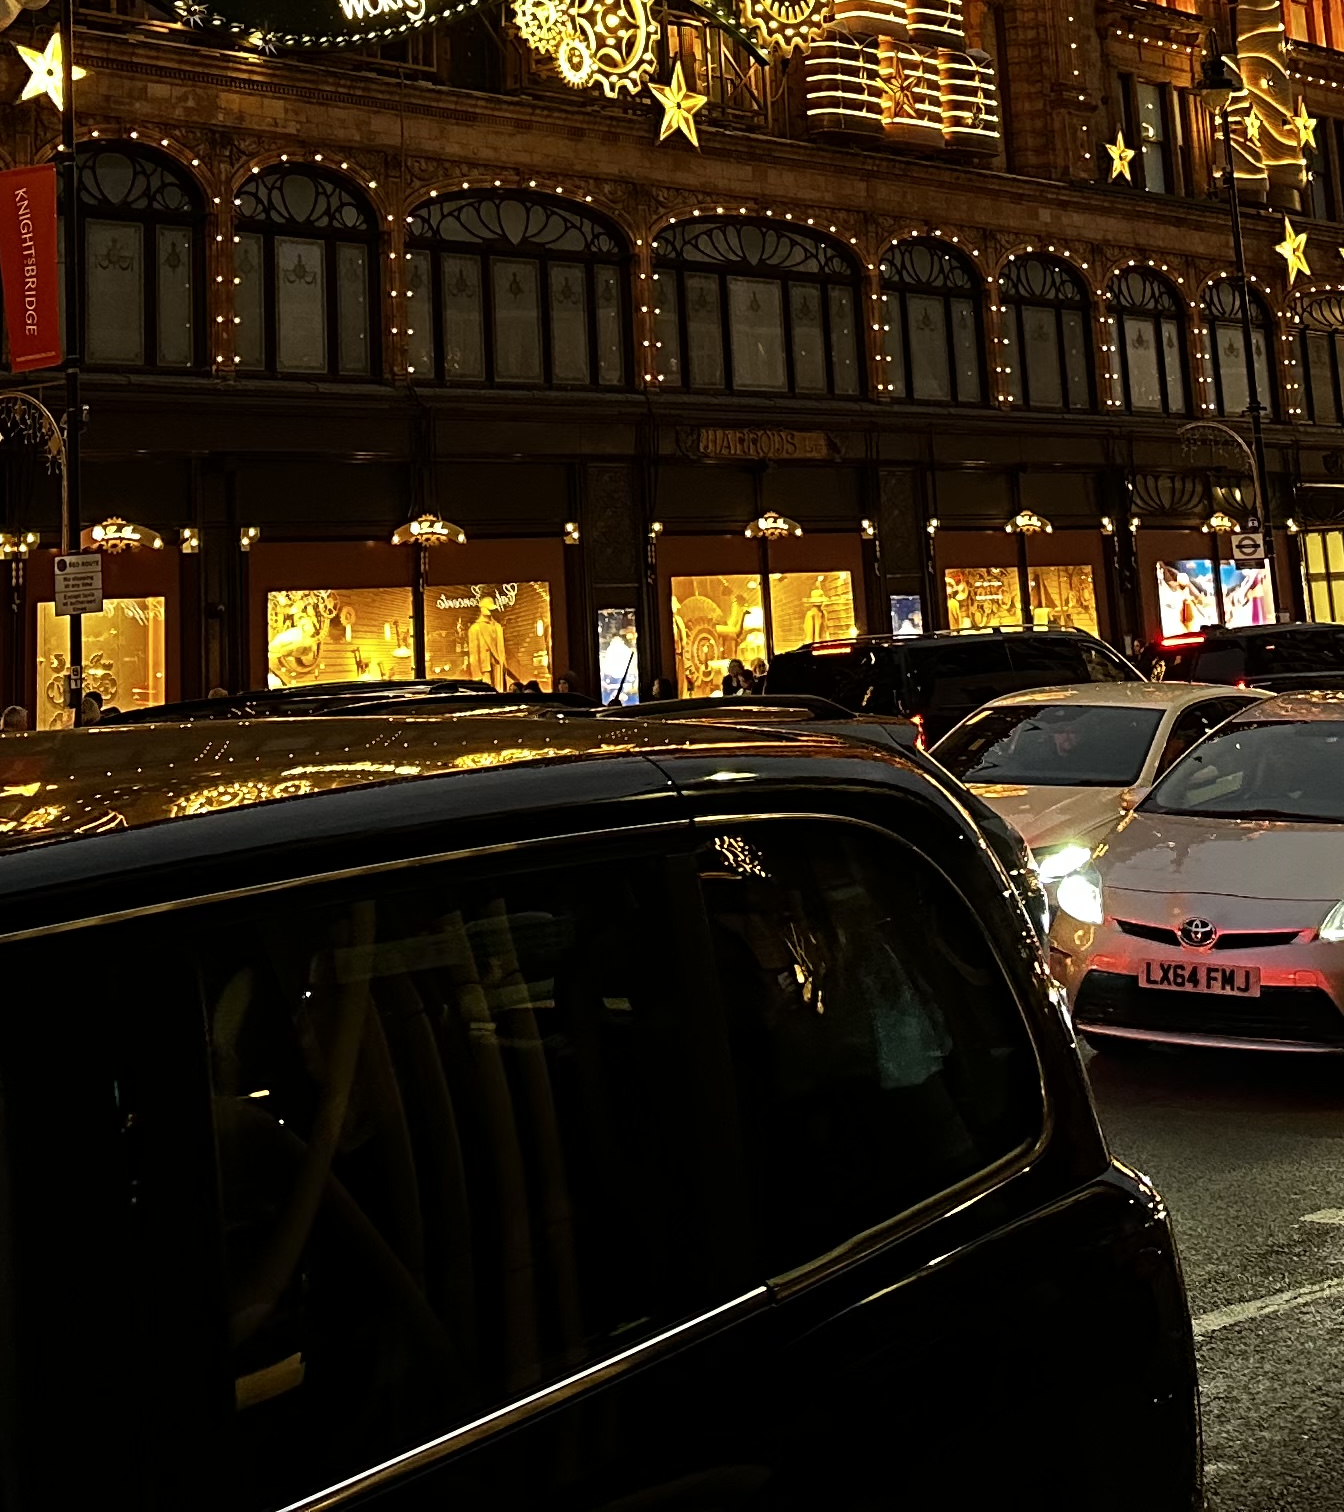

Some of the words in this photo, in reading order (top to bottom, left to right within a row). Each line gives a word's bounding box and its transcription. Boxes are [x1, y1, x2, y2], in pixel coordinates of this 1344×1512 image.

[702, 429, 797, 456] HARRODS
[1145, 961, 1201, 992] LX64
[1204, 967, 1252, 995] FMJ
